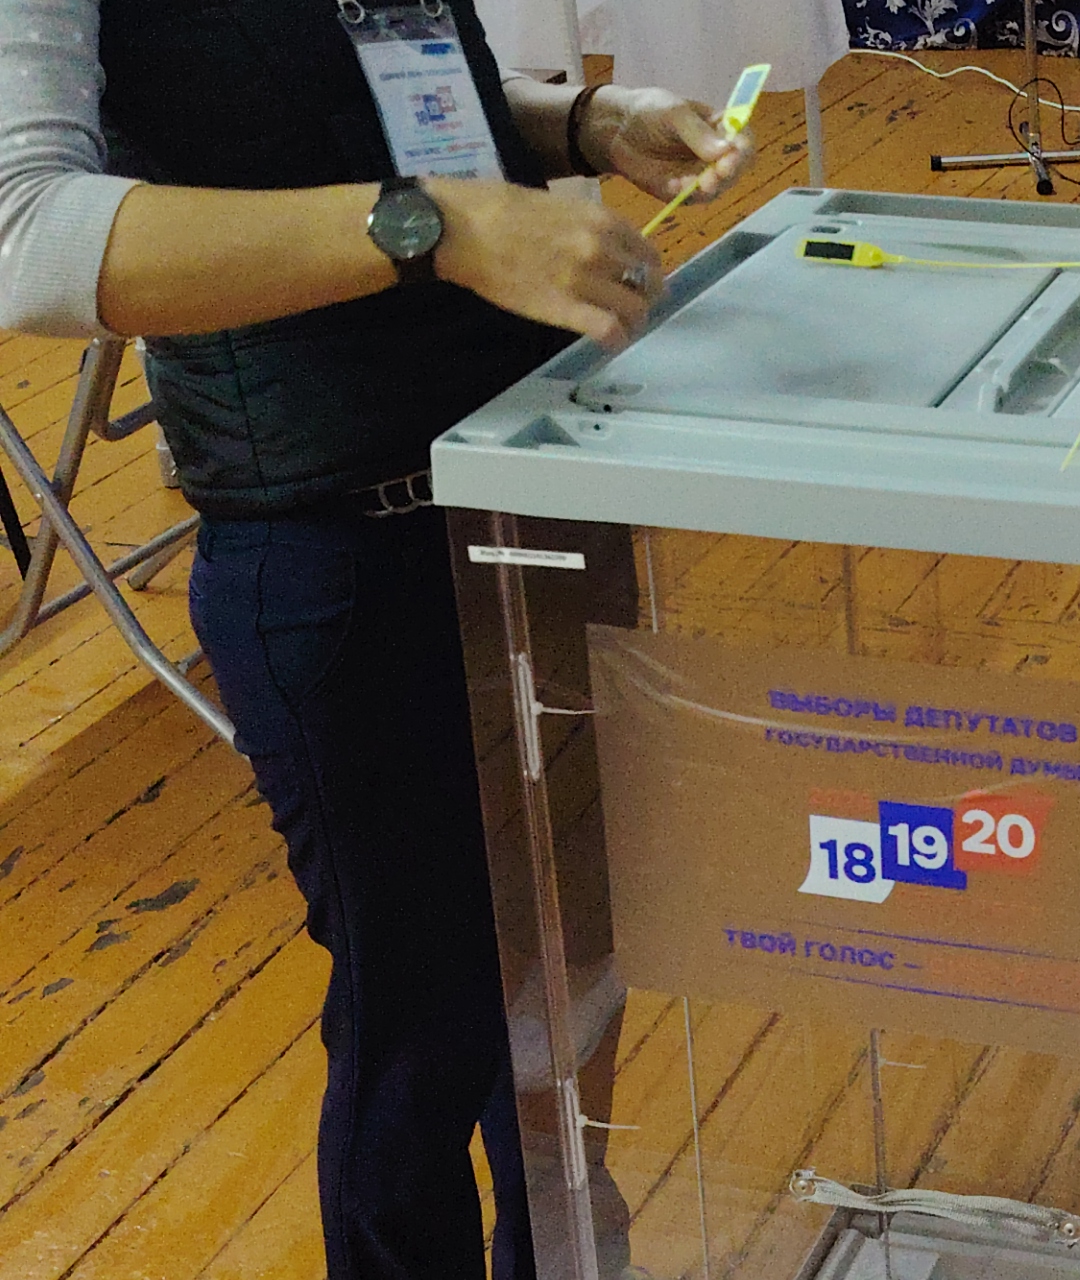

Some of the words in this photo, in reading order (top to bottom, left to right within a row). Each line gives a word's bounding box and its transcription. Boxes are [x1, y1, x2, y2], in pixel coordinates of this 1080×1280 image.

[768, 689, 897, 723] ВЫБОРЫ
[904, 705, 1078, 743] ДЕПУТАТОВ
[764, 726, 1004, 770] ГОСУДАРСТВЕННОЙ
[819, 839, 876, 884] 18
[888, 823, 948, 870] 19
[962, 809, 1036, 859] 20
[722, 926, 797, 956] ТВОЙ
[804, 939, 897, 970] ГОЛОС
